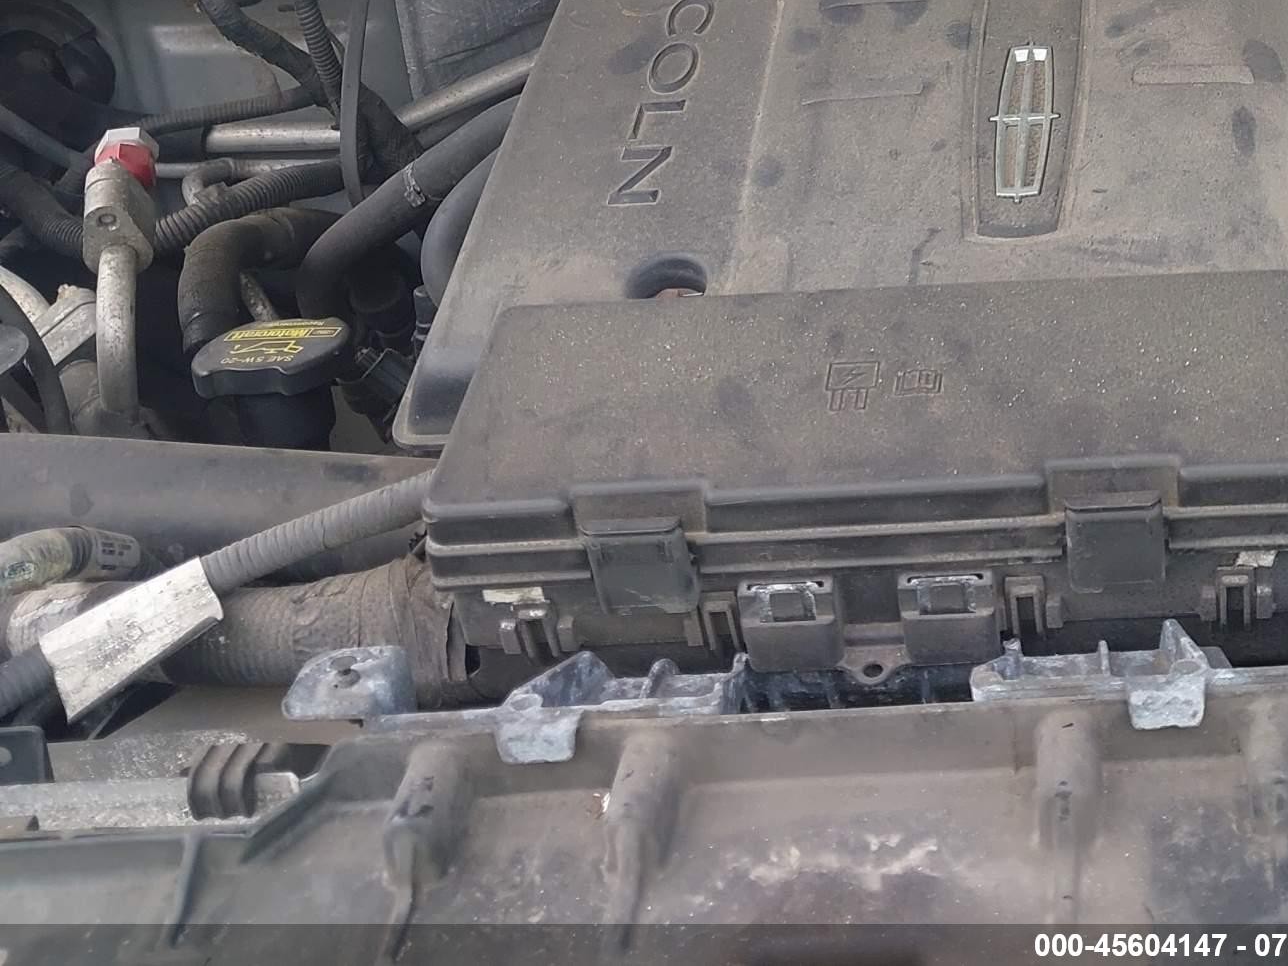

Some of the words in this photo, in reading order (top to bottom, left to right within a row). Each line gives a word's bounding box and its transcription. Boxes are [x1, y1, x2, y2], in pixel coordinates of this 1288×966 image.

[231, 328, 307, 339] Motorcraft
[221, 356, 264, 364] 5W-20
[266, 355, 294, 363] SAE
